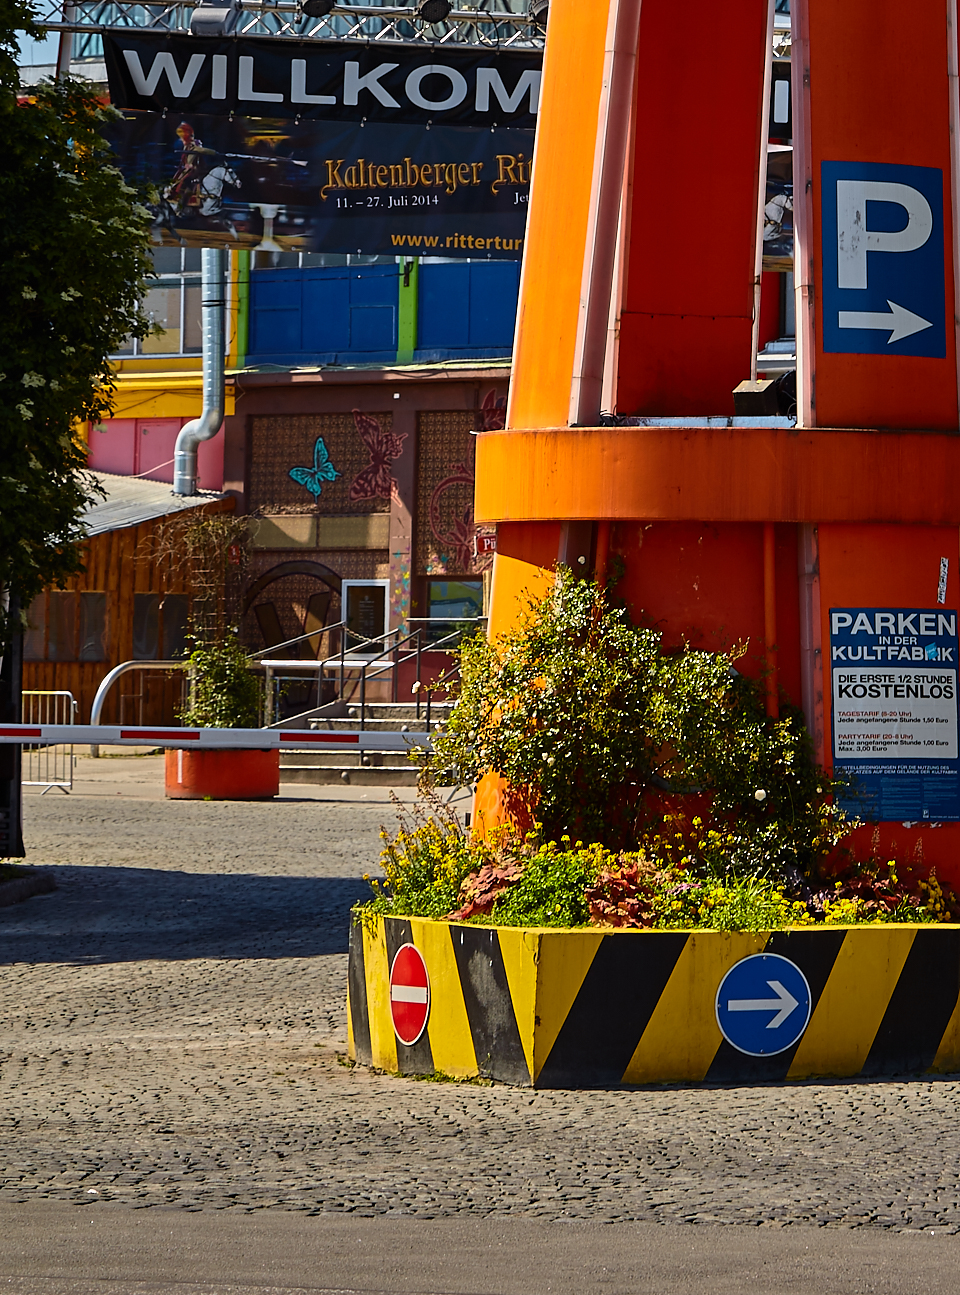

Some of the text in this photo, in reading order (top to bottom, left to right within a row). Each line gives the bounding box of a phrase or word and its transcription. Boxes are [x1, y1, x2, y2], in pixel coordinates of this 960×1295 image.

[320, 157, 484, 201] Kaltenberger
[336, 194, 439, 209] 11. 27. Juli 2014
[390, 233, 522, 250] www.rittertur
[837, 179, 933, 290] P
[831, 612, 956, 636] PARKEN
[879, 636, 917, 645] IN DER
[838, 674, 953, 684] DIE ERSTE 1/2 STUNDE
[838, 684, 954, 699] KOSTENLOS
